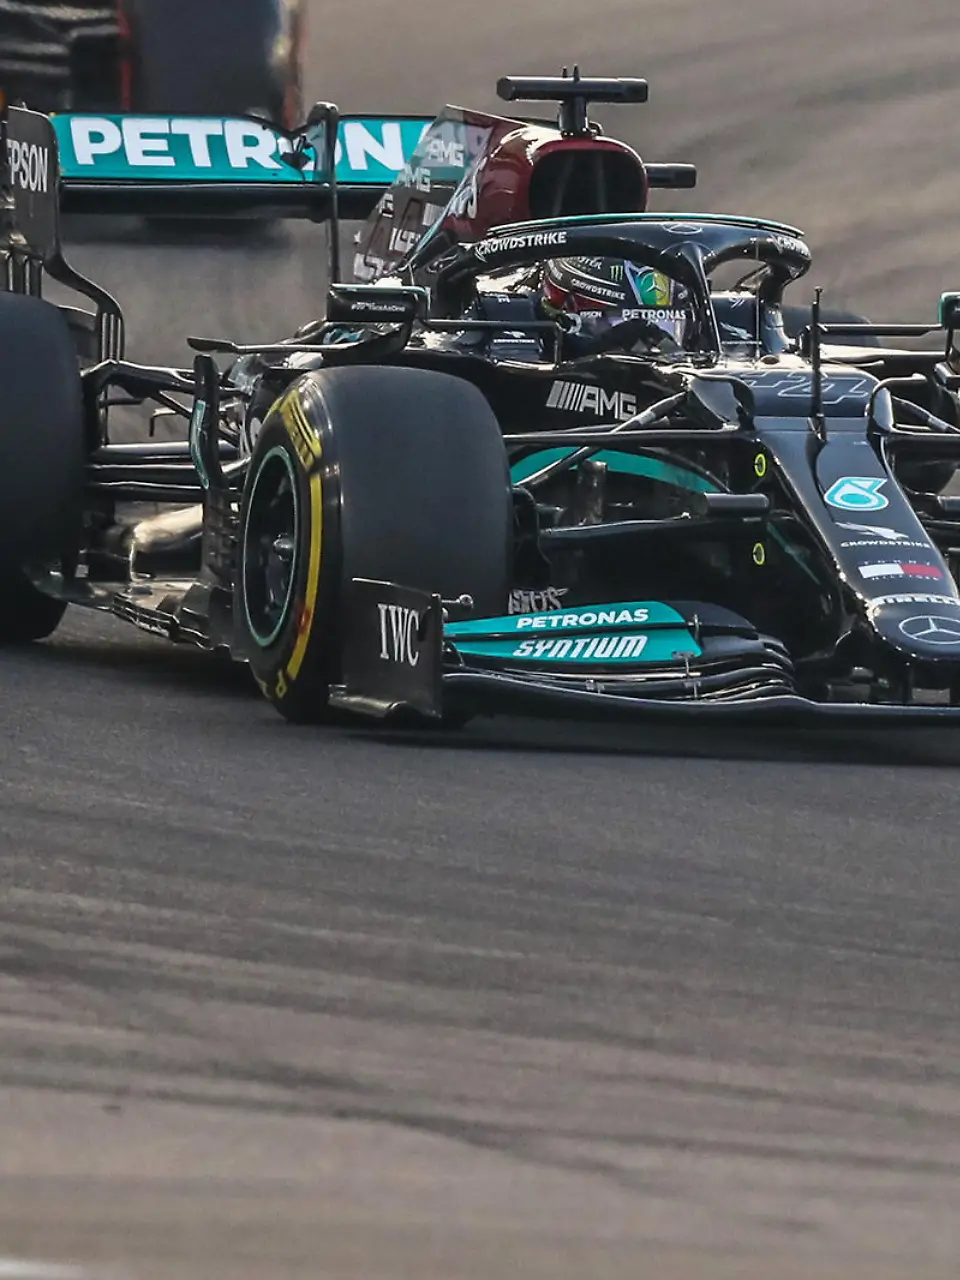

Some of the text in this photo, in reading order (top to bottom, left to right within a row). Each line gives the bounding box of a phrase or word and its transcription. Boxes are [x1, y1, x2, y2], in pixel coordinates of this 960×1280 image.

[479, 231, 567, 256] CROWDSTRIKE
[571, 278, 626, 300] CROWDSTRIKE
[622, 308, 687, 321] PETRONAS
[577, 384, 638, 421] AMG
[516, 608, 649, 629] PETRONAS
[377, 604, 419, 667] IWC
[512, 634, 648, 658] SYNTIUM
